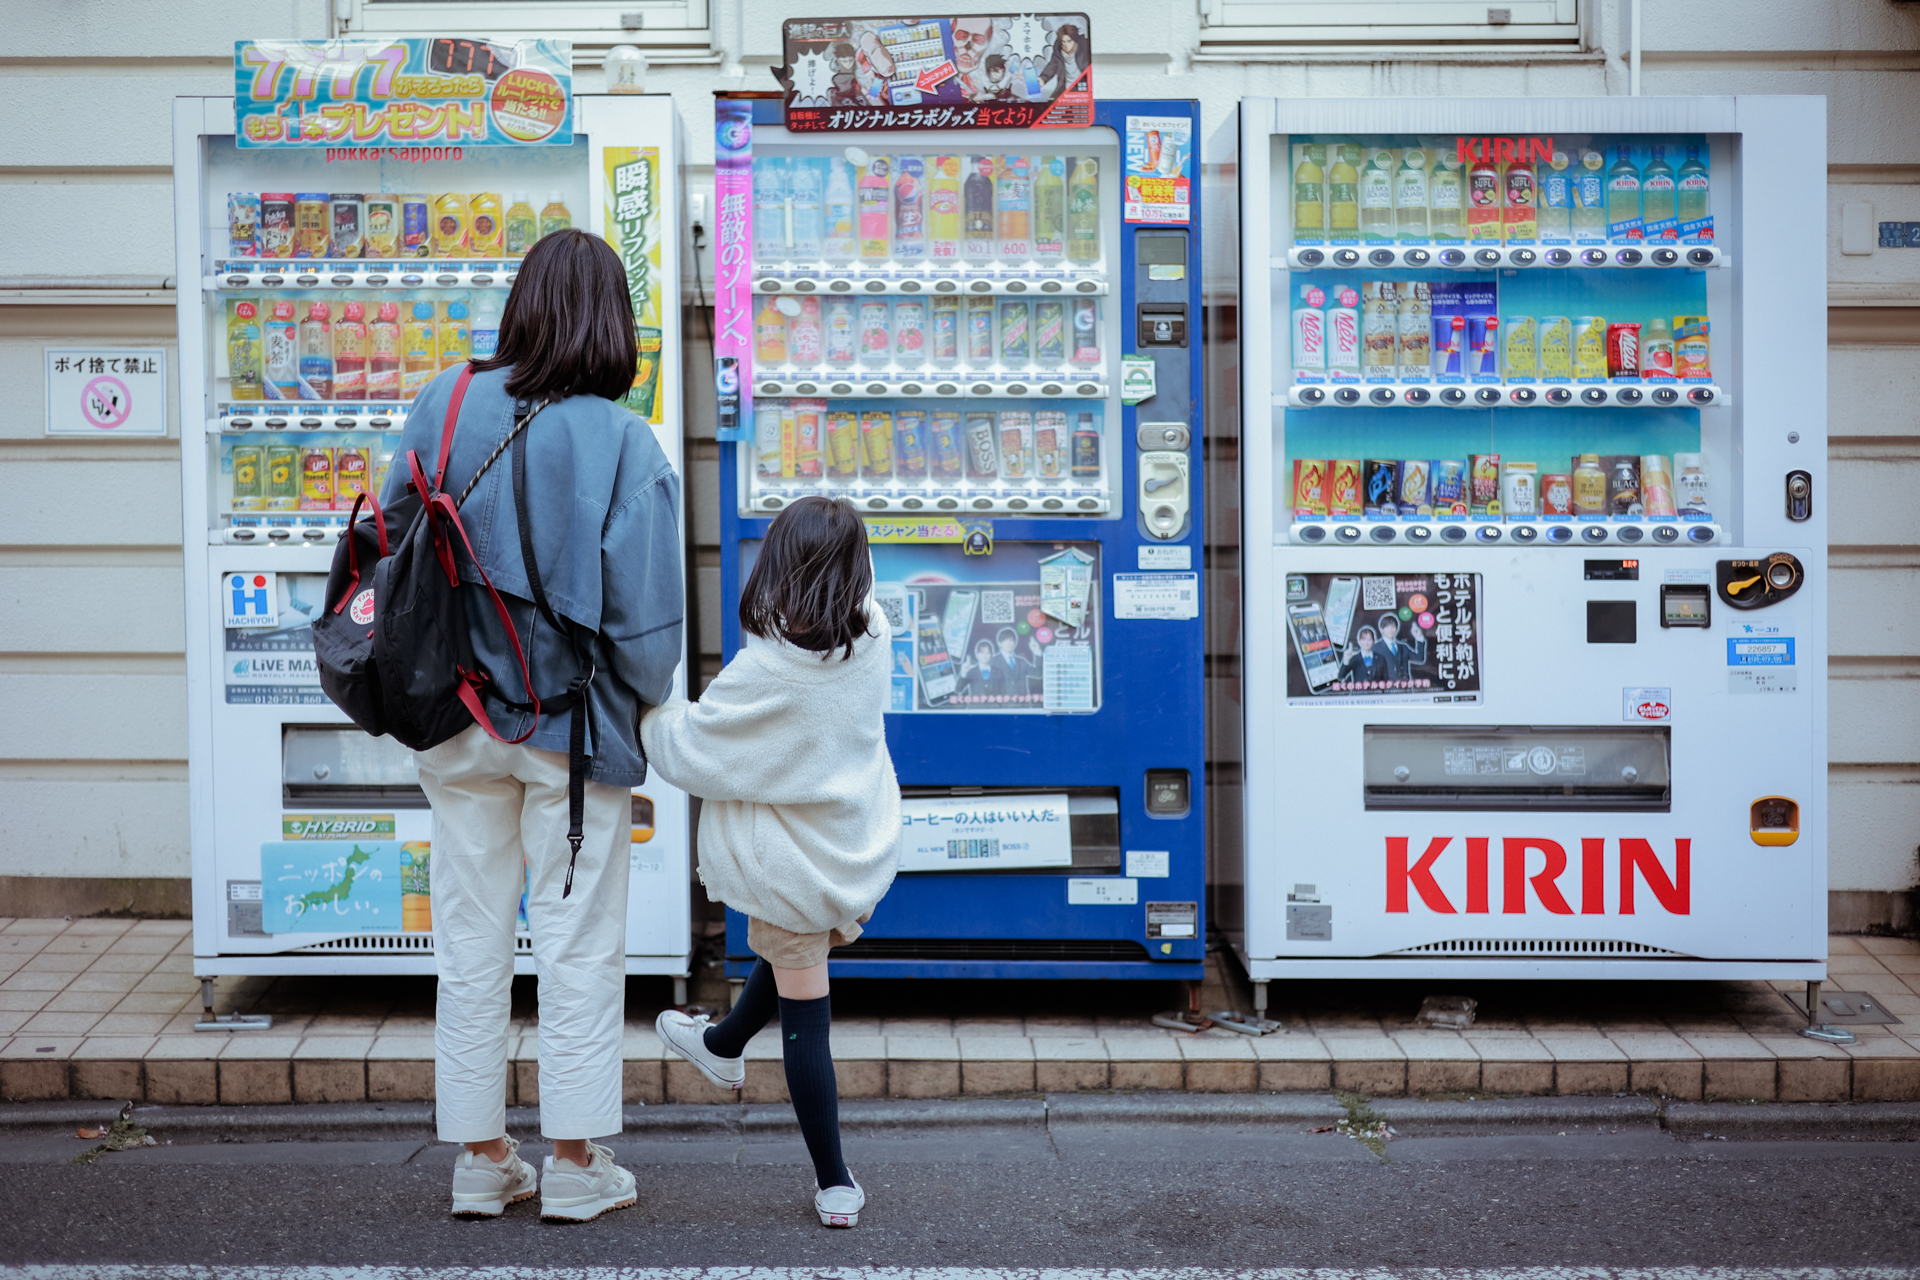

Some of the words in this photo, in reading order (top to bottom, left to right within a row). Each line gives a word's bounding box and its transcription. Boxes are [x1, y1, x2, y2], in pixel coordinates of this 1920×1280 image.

[508, 74, 558, 96] LUCKY
[497, 85, 561, 110] ルーレットで
[790, 111, 821, 120] 自販機に
[790, 121, 826, 130] タッチして
[1127, 131, 1145, 172] NEW
[1456, 137, 1554, 163] KIRIN
[903, 211, 916, 226] 生
[271, 335, 283, 365] 麦茶
[1621, 330, 1638, 370] Mets
[55, 357, 158, 374] ポイ捨て禁止
[974, 428, 995, 472] BOSS
[228, 616, 274, 625] HACHIYOH
[1433, 574, 1457, 690] もっと便利に。
[1453, 573, 1475, 680] ホテル予約が
[1747, 645, 1777, 653] 226857
[302, 820, 377, 838] HYBRID
[902, 809, 1060, 826] コーヒーの人はいい人だ。
[278, 857, 382, 882] ニッポンの
[1385, 836, 1692, 915] KIRIN
[284, 893, 379, 917] おいしい。
